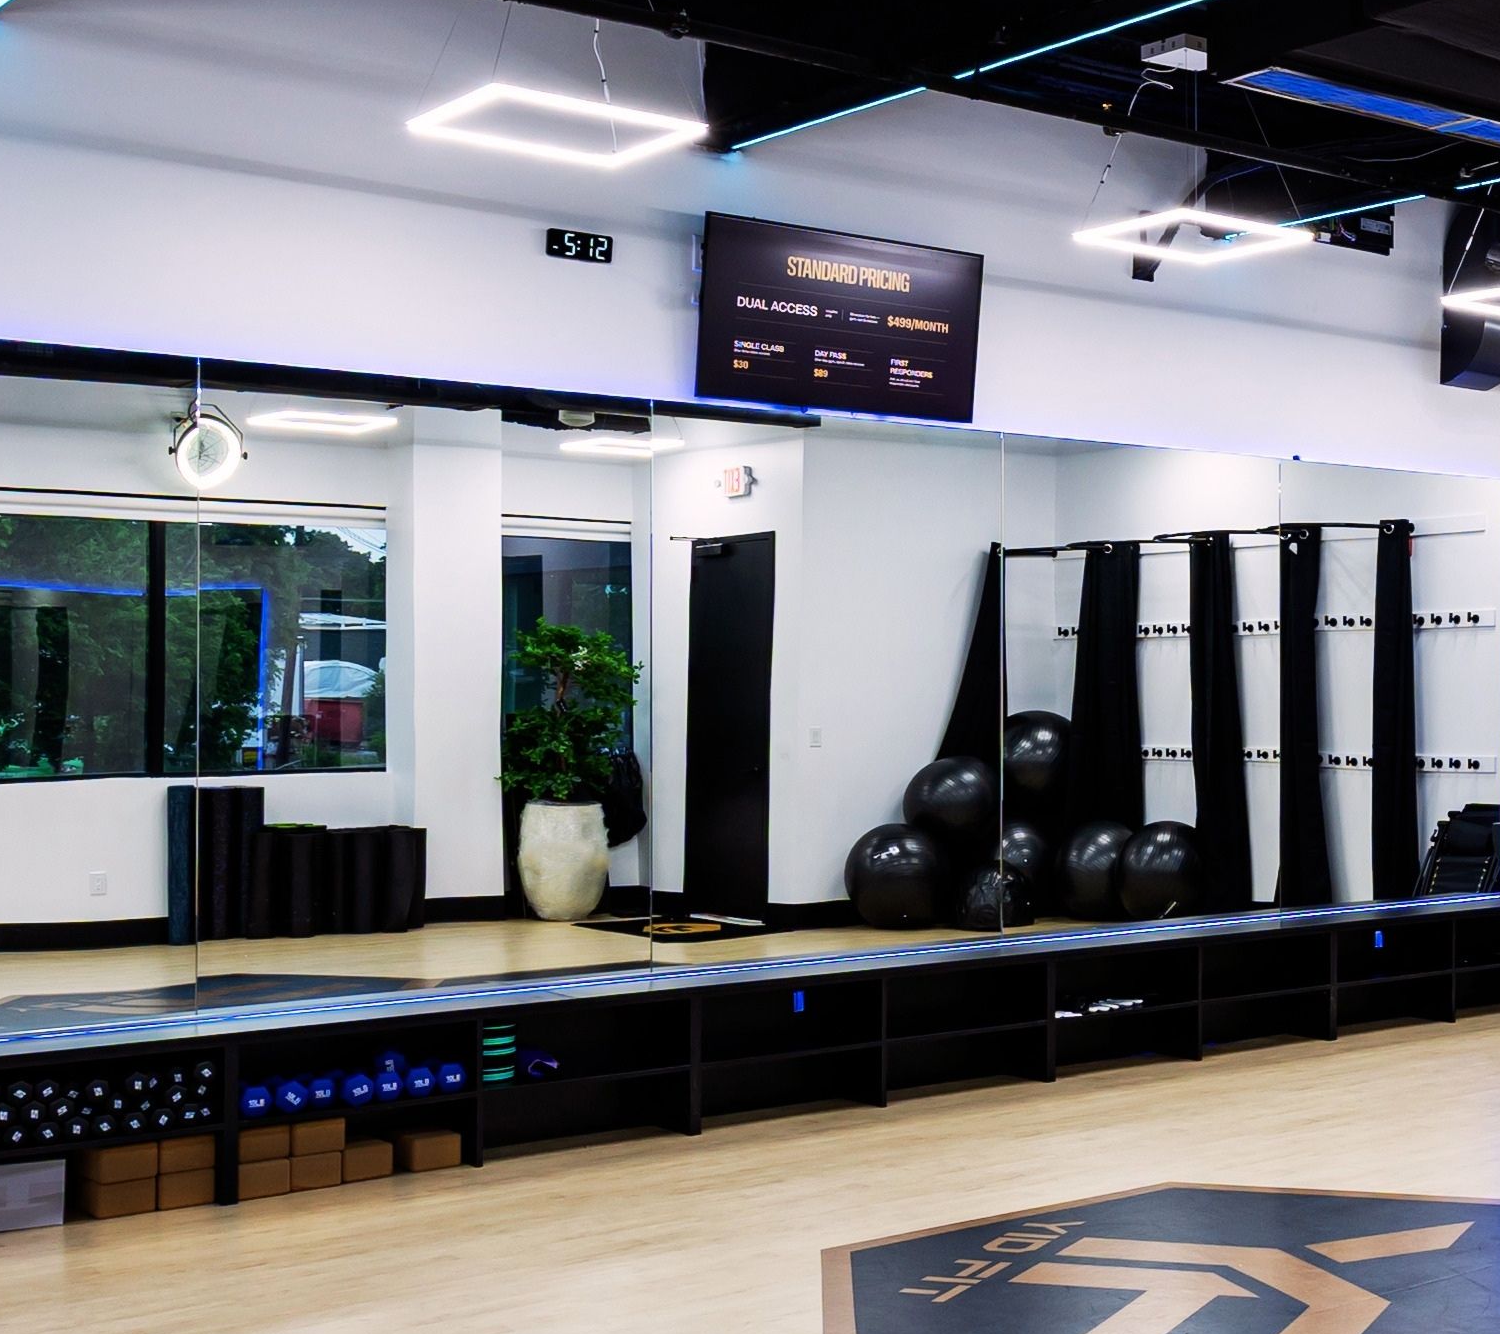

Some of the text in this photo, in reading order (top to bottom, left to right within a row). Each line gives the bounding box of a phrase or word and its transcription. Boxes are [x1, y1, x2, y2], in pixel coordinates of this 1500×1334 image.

[787, 256, 910, 293] STANDARD PRICING
[736, 295, 768, 311] DUAL
[770, 300, 818, 317] ACCESS
[887, 314, 949, 334] $499/MONTH
[733, 340, 760, 350] SINGLE
[761, 343, 785, 353] CLASS
[814, 349, 847, 360] DAY PASS
[890, 358, 909, 367] FIRST
[889, 367, 933, 379] RESPONDERS
[898, 1221, 1087, 1303] YID FIT
